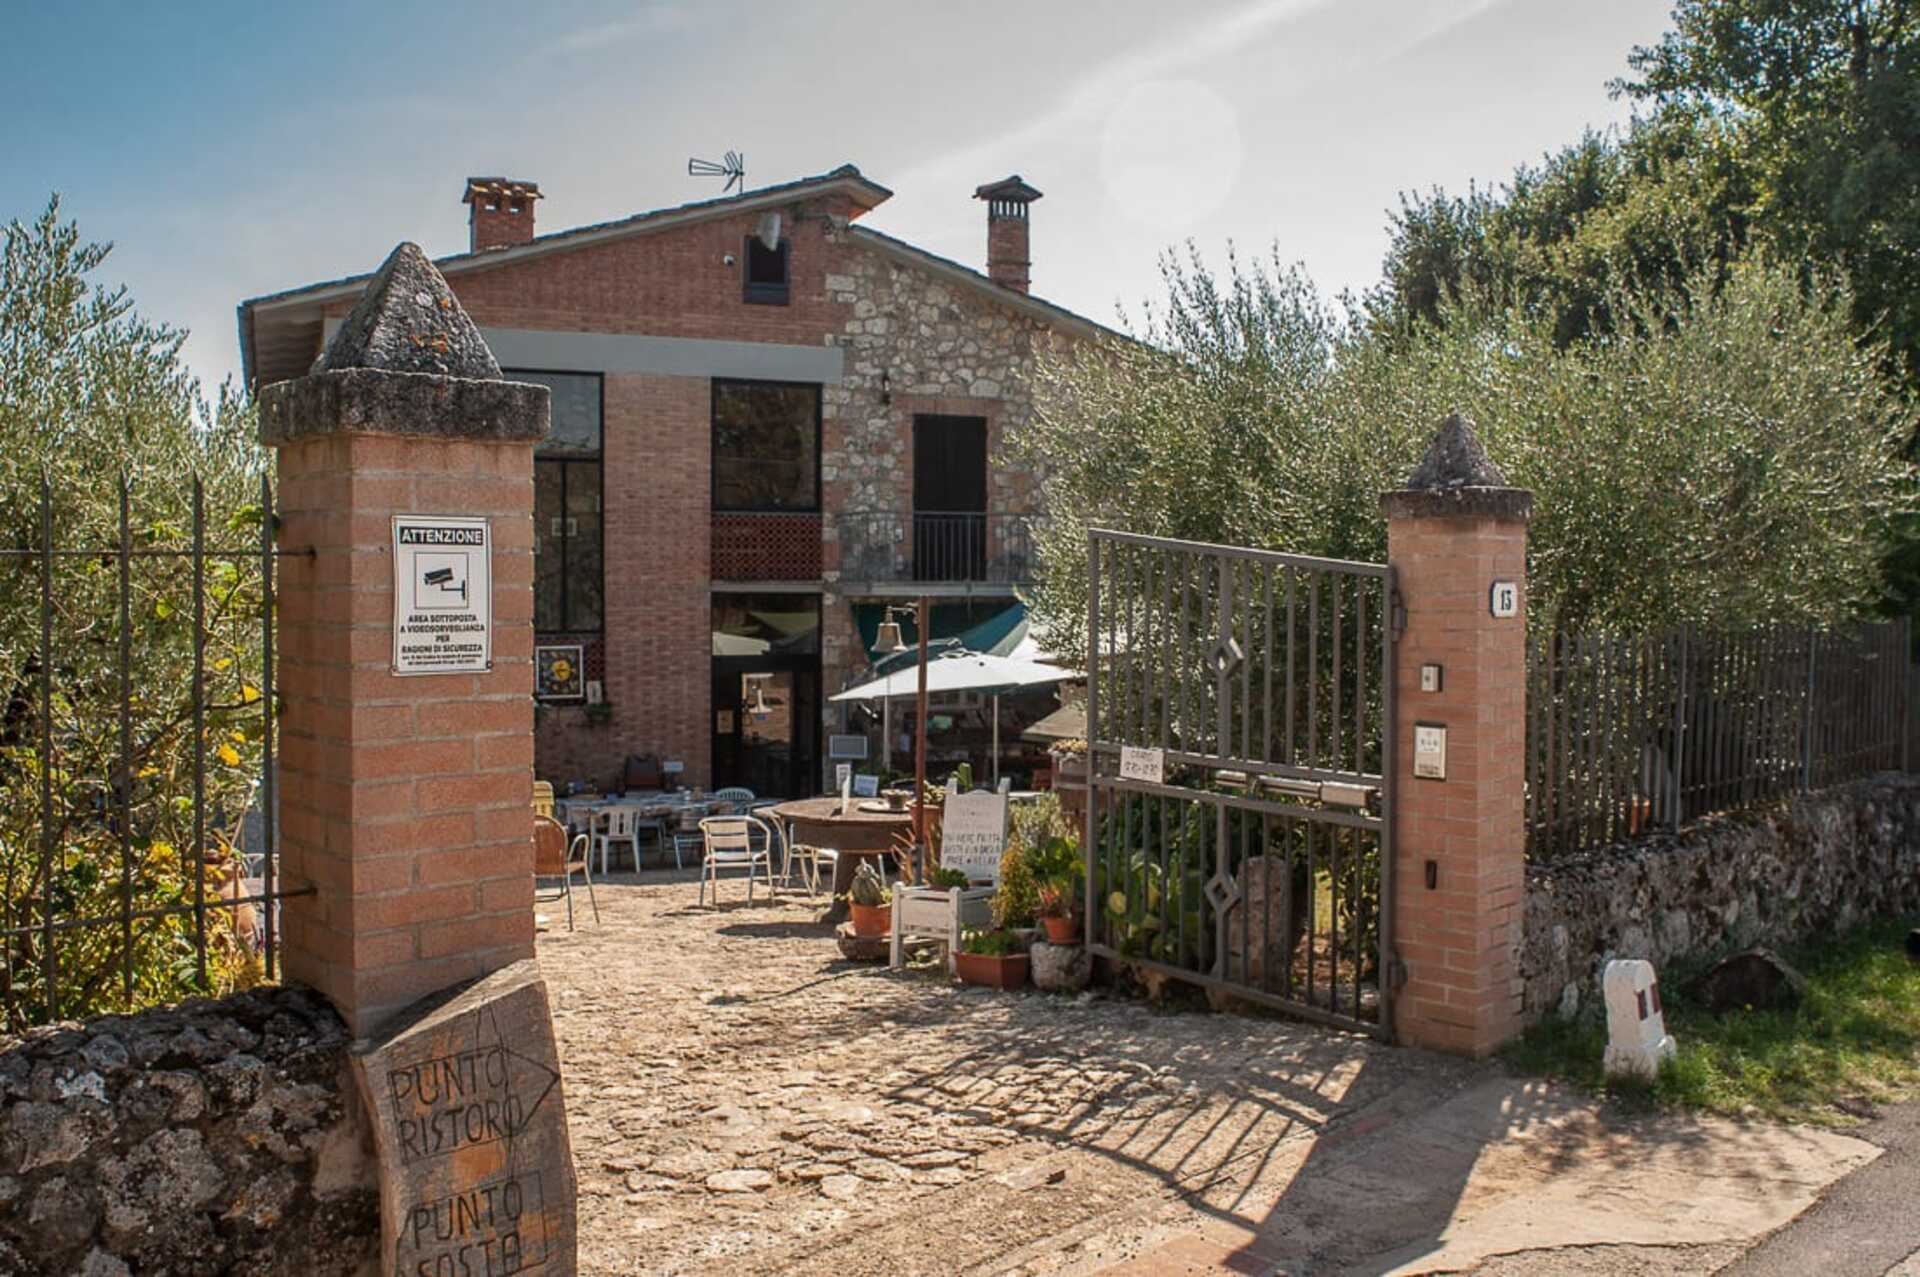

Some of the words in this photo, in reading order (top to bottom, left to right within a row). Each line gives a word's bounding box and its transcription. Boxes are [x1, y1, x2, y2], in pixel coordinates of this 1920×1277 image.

[401, 528, 483, 544] ATTENZIONE
[1501, 590, 1512, 610] 13
[409, 614, 429, 622] AREA
[430, 614, 477, 622] SOTTOPOSTA
[400, 625, 406, 633] A
[407, 624, 486, 633] VIDEOSORVEGLIANZA
[443, 644, 483, 652] SICUREZZA
[391, 1048, 507, 1113] PUNTO
[399, 1094, 522, 1162] RISTORO
[413, 1180, 523, 1248] PUNTO
